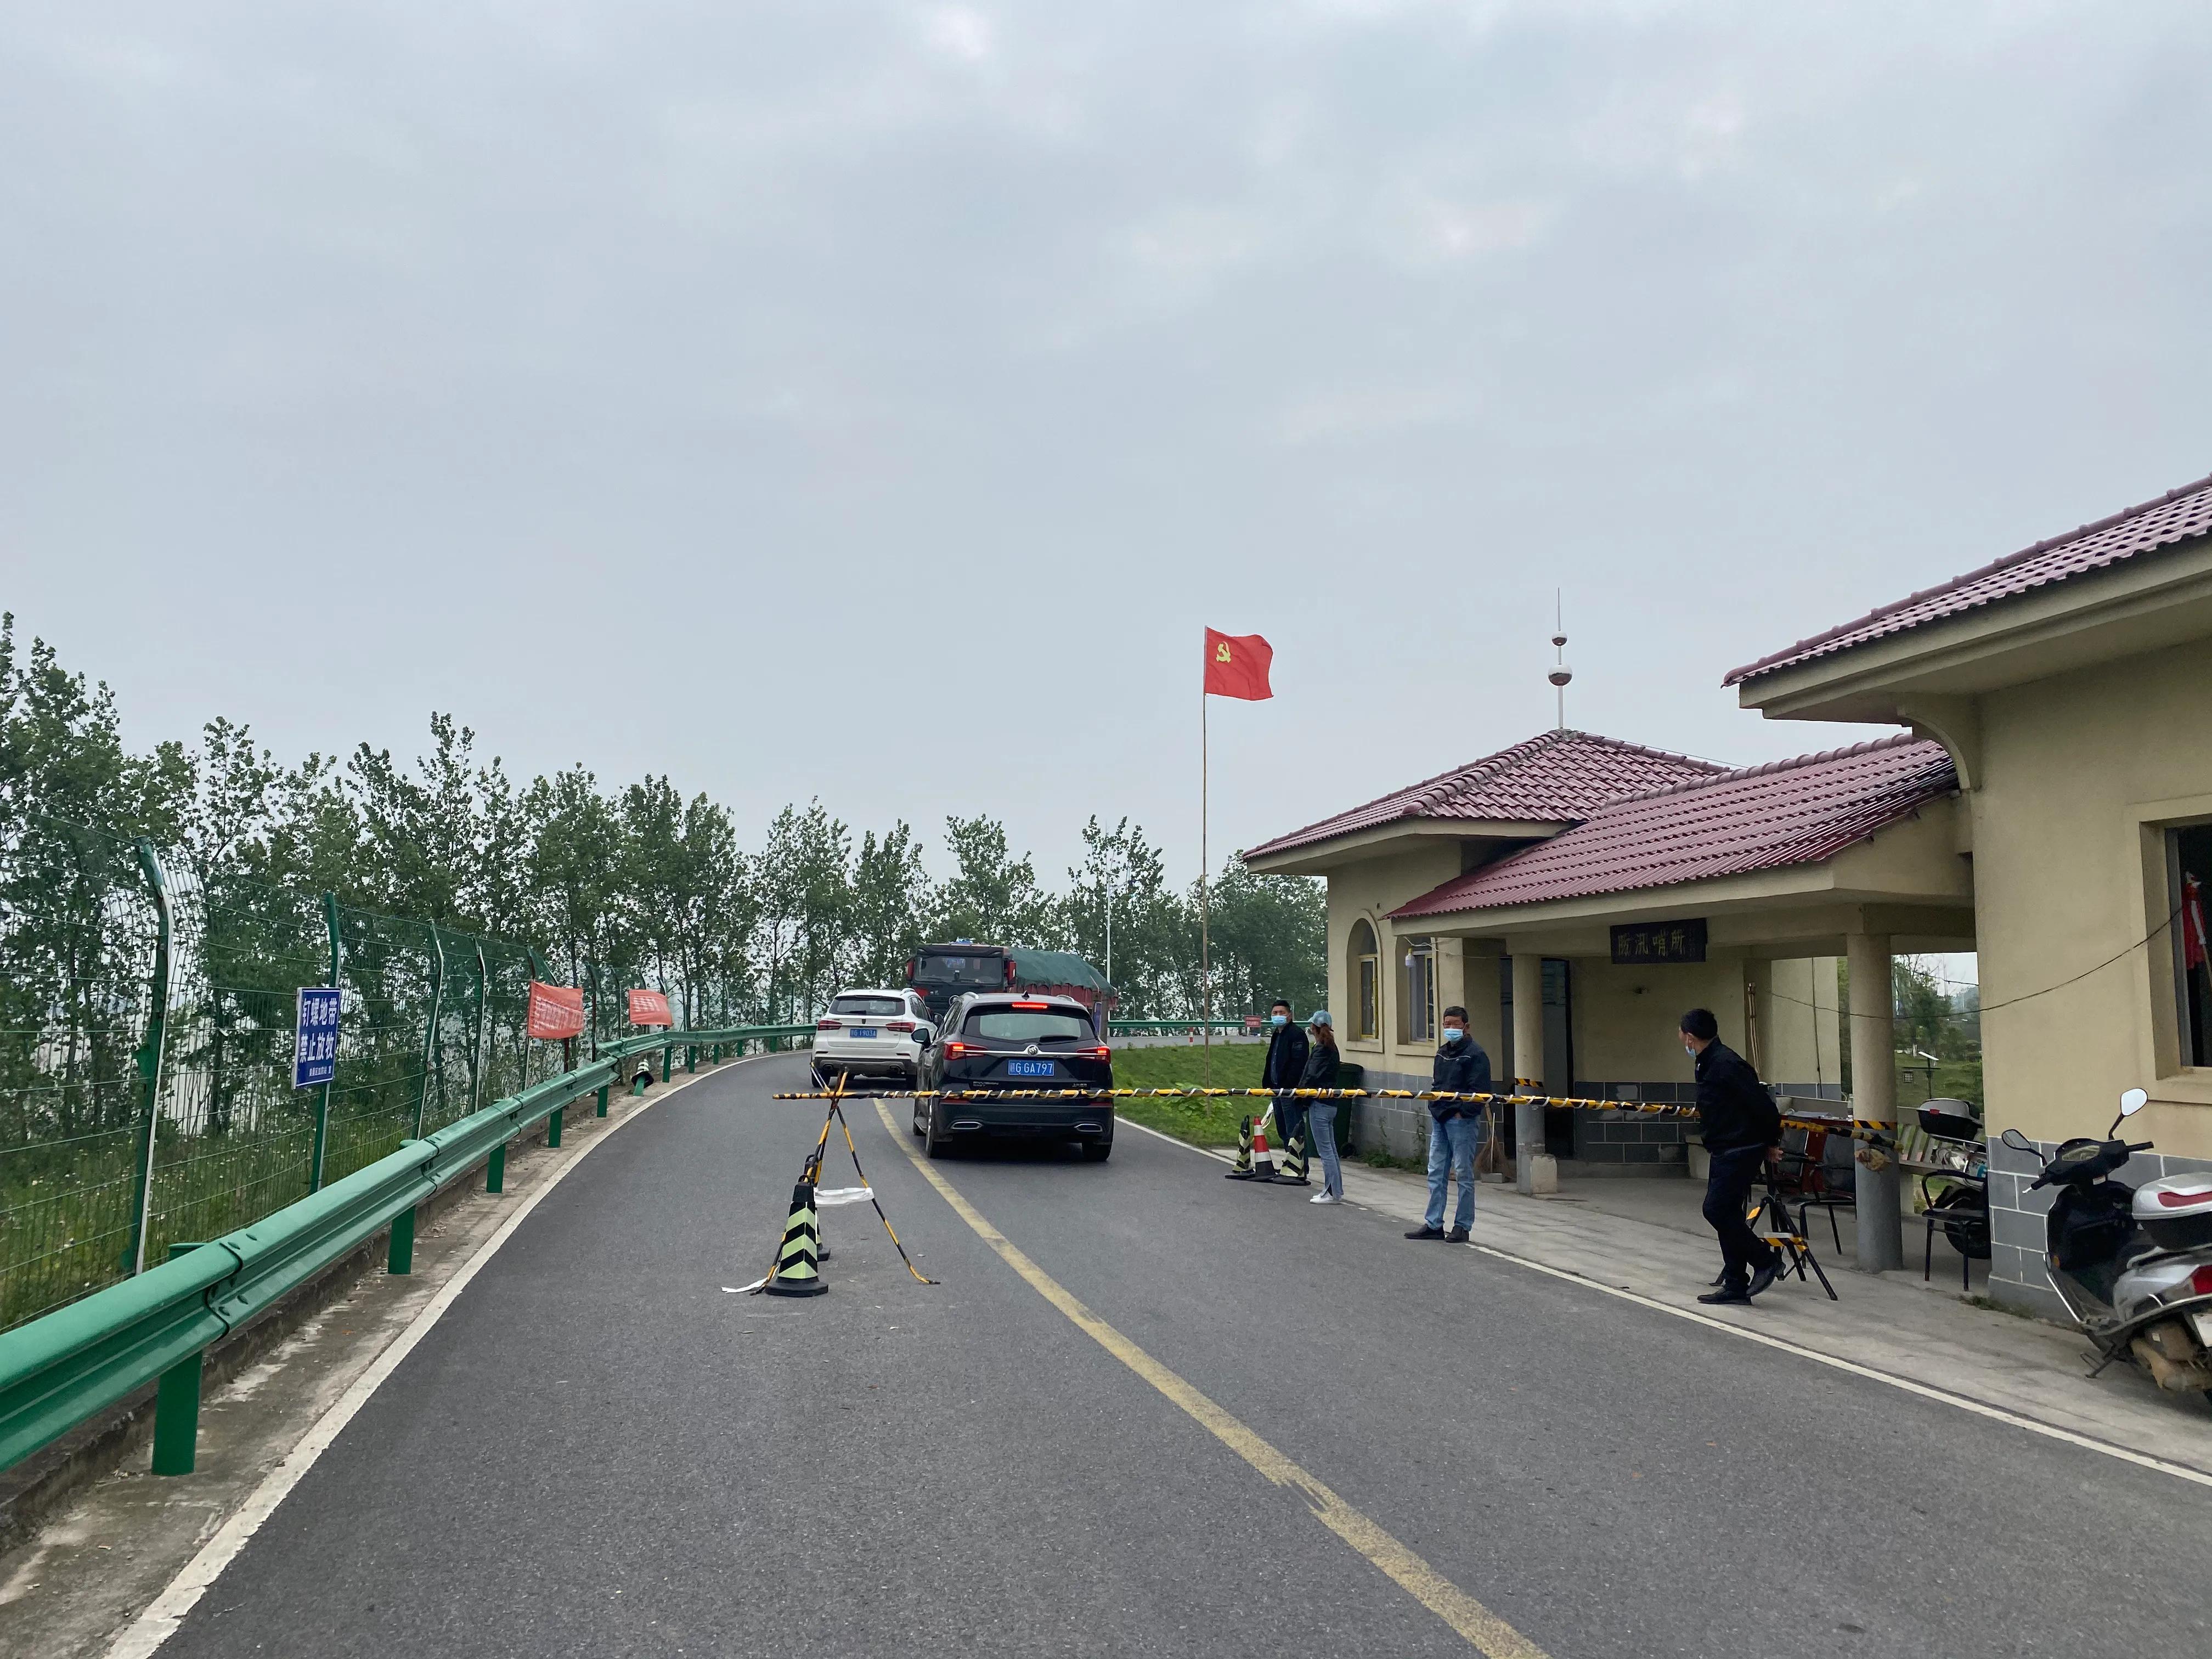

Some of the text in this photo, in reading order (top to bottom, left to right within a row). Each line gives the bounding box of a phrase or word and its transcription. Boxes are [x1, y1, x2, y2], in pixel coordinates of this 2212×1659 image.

[1618, 929, 1685, 957] 防汛哨所
[303, 998, 337, 1026] 钉螺地带
[300, 1032, 334, 1063] 禁止放牧
